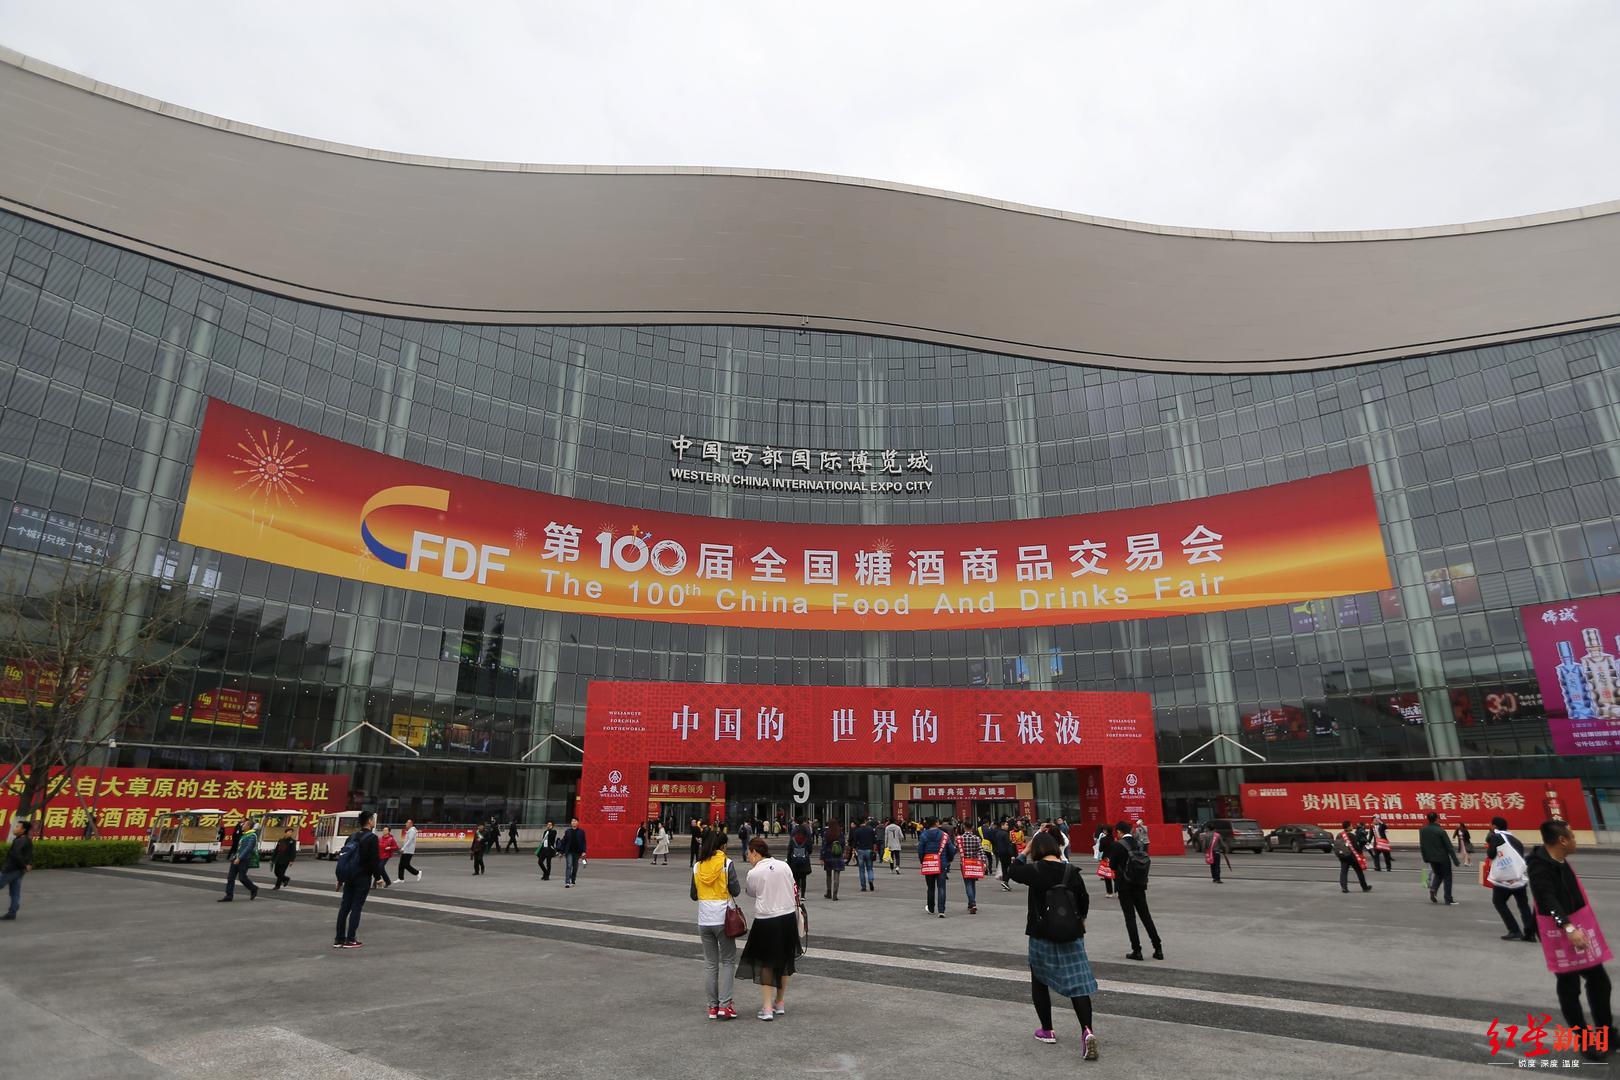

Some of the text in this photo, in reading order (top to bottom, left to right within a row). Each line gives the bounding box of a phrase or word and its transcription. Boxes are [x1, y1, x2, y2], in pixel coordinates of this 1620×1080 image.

[672, 434, 933, 474] 中国西部国际博览城
[671, 467, 933, 492] WESTERN CHINA INTERNATIONAL EXPO CITY
[541, 521, 1224, 587] 第100届全国糖酒商品交易会
[540, 568, 1225, 615] The 100th China Food And Drinks Fair
[672, 704, 1082, 745] 中国的 世界的 五粮液
[792, 772, 811, 803] 9
[1302, 793, 1403, 810] 贵州国台酒
[1415, 791, 1525, 810] 酱香新领秀
